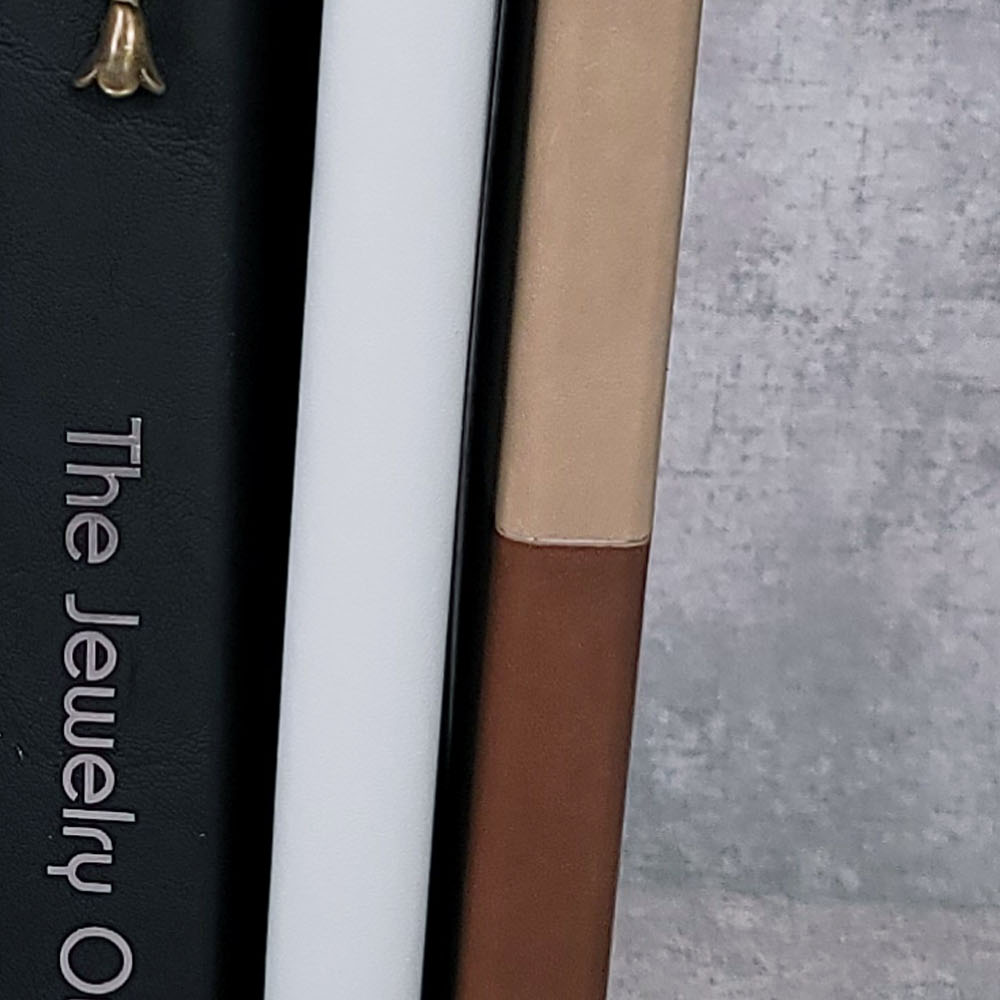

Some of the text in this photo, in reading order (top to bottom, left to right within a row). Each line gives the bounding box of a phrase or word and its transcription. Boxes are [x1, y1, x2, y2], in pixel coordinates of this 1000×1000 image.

[46, 417, 142, 1000] The Jewelry O
